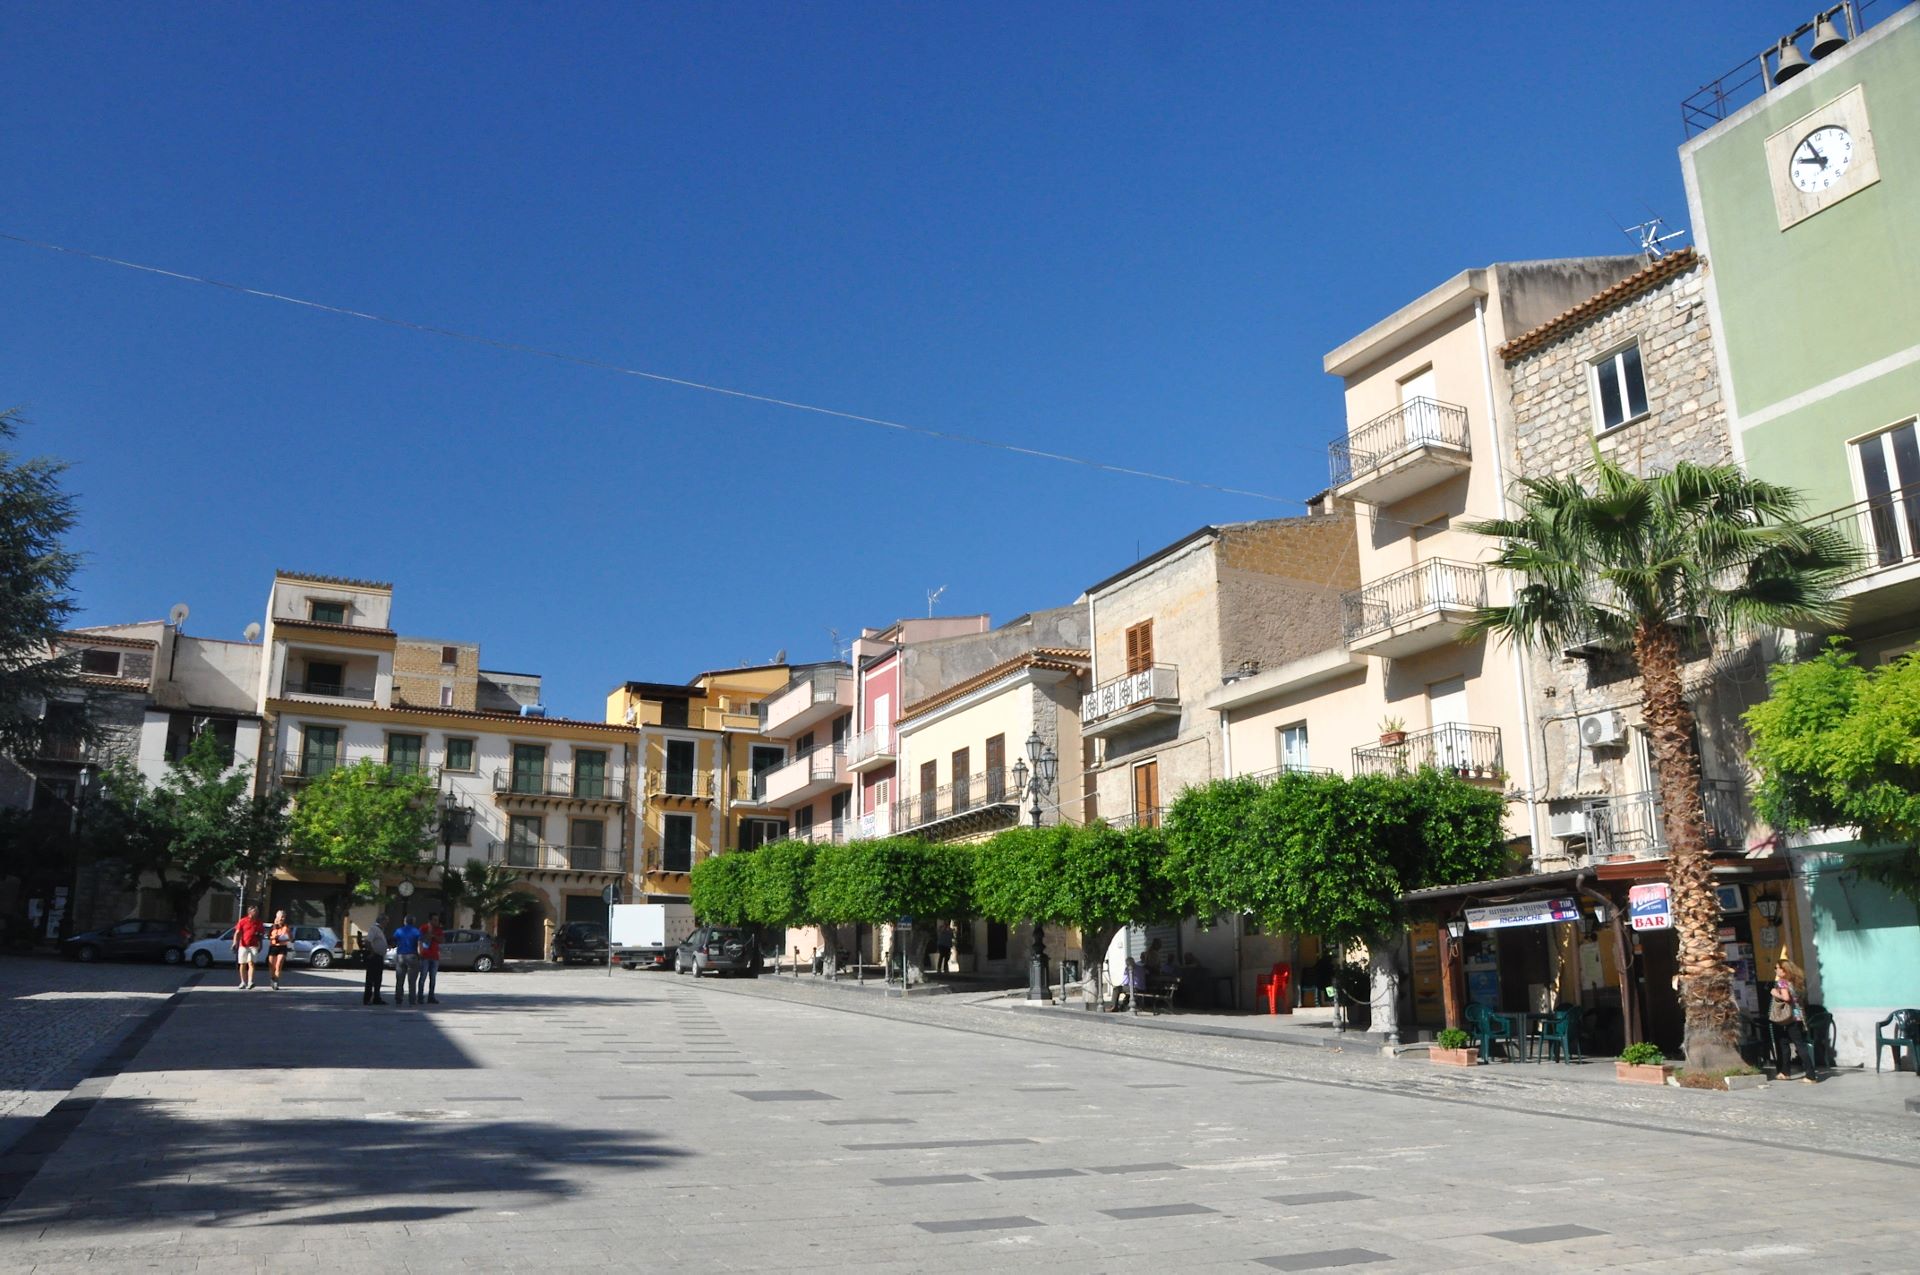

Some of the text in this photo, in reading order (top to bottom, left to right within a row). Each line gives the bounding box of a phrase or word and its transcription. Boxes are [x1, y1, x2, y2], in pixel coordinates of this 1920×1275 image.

[1814, 133, 1821, 142] 12
[1838, 132, 1844, 140] 2
[1559, 900, 1571, 908] TIM
[1489, 907, 1519, 915] ELETTRONICA
[1562, 910, 1575, 918] TIM
[1500, 914, 1543, 924] RICARICHE
[1634, 916, 1664, 928] BAR
